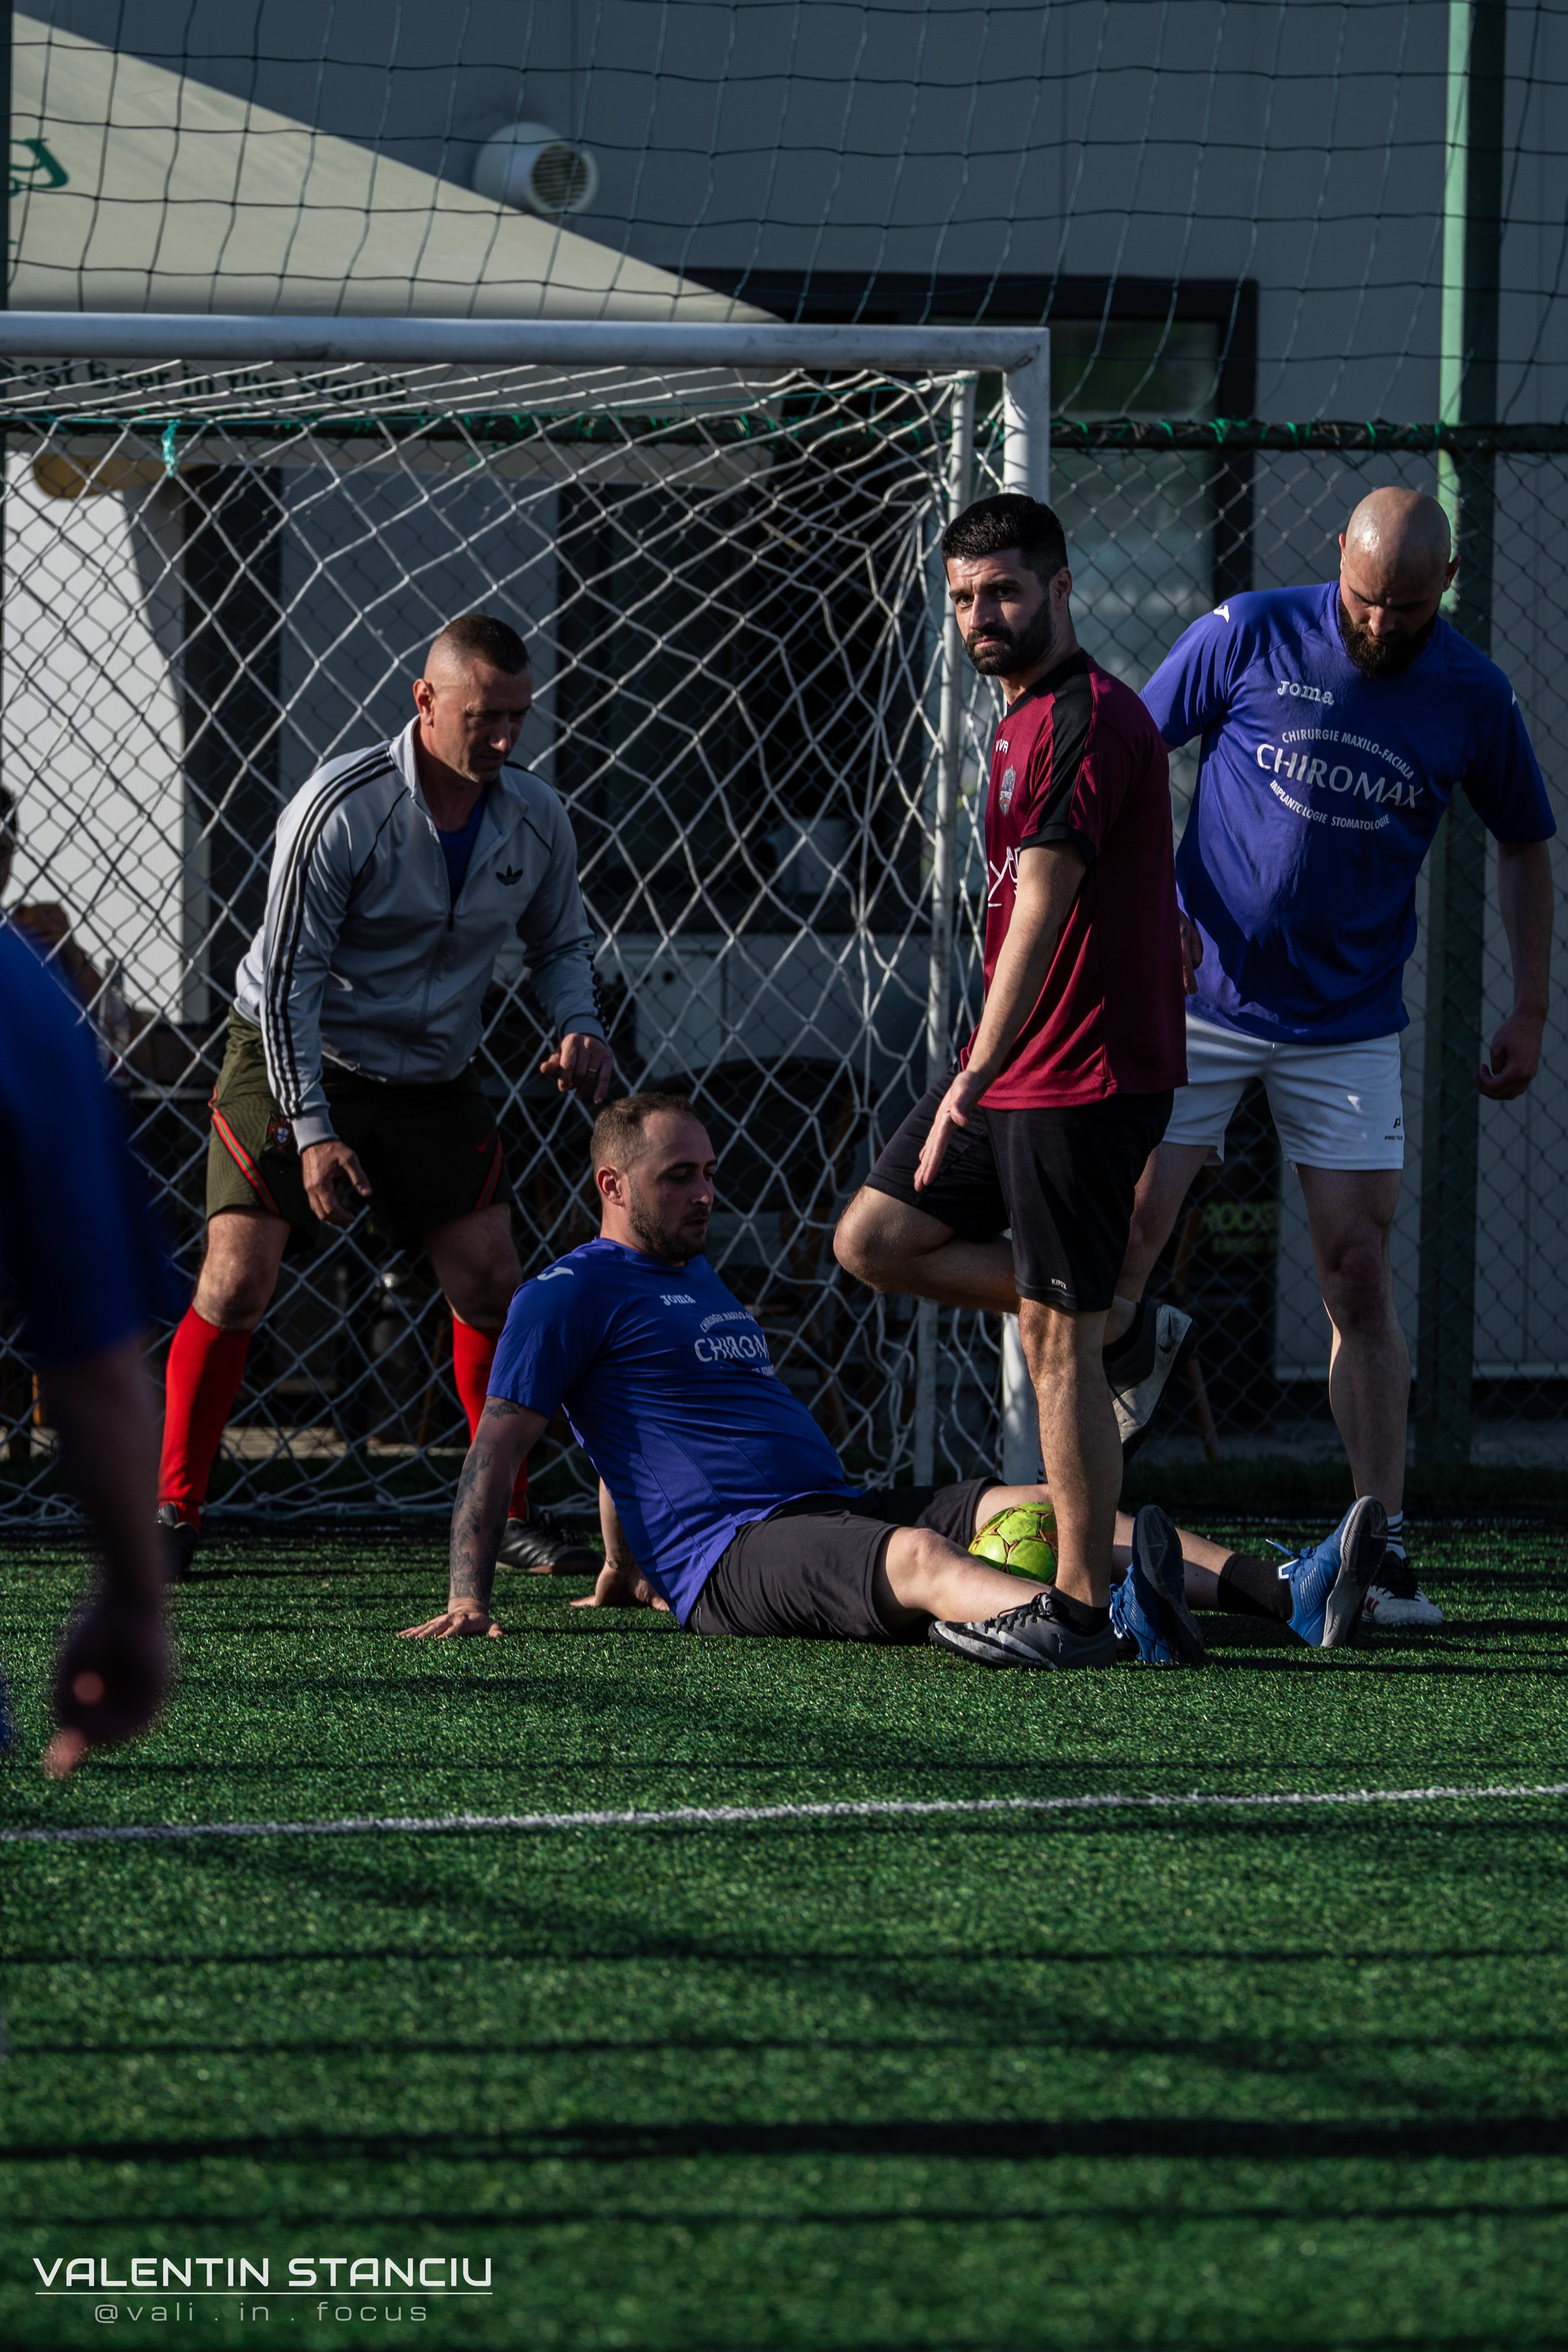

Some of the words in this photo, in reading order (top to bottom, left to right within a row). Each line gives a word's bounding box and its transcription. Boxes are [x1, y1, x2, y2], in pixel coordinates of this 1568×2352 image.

[183, 365, 214, 394] in
[1256, 743, 1424, 810] CHIROMAX
[1281, 728, 1340, 744] CHIRURGIE
[1341, 732, 1414, 781] MAXILO-FACIALA
[1269, 779, 1329, 824] IMPLANTOLOGIE
[1330, 813, 1390, 831] STOMATOLOGIE
